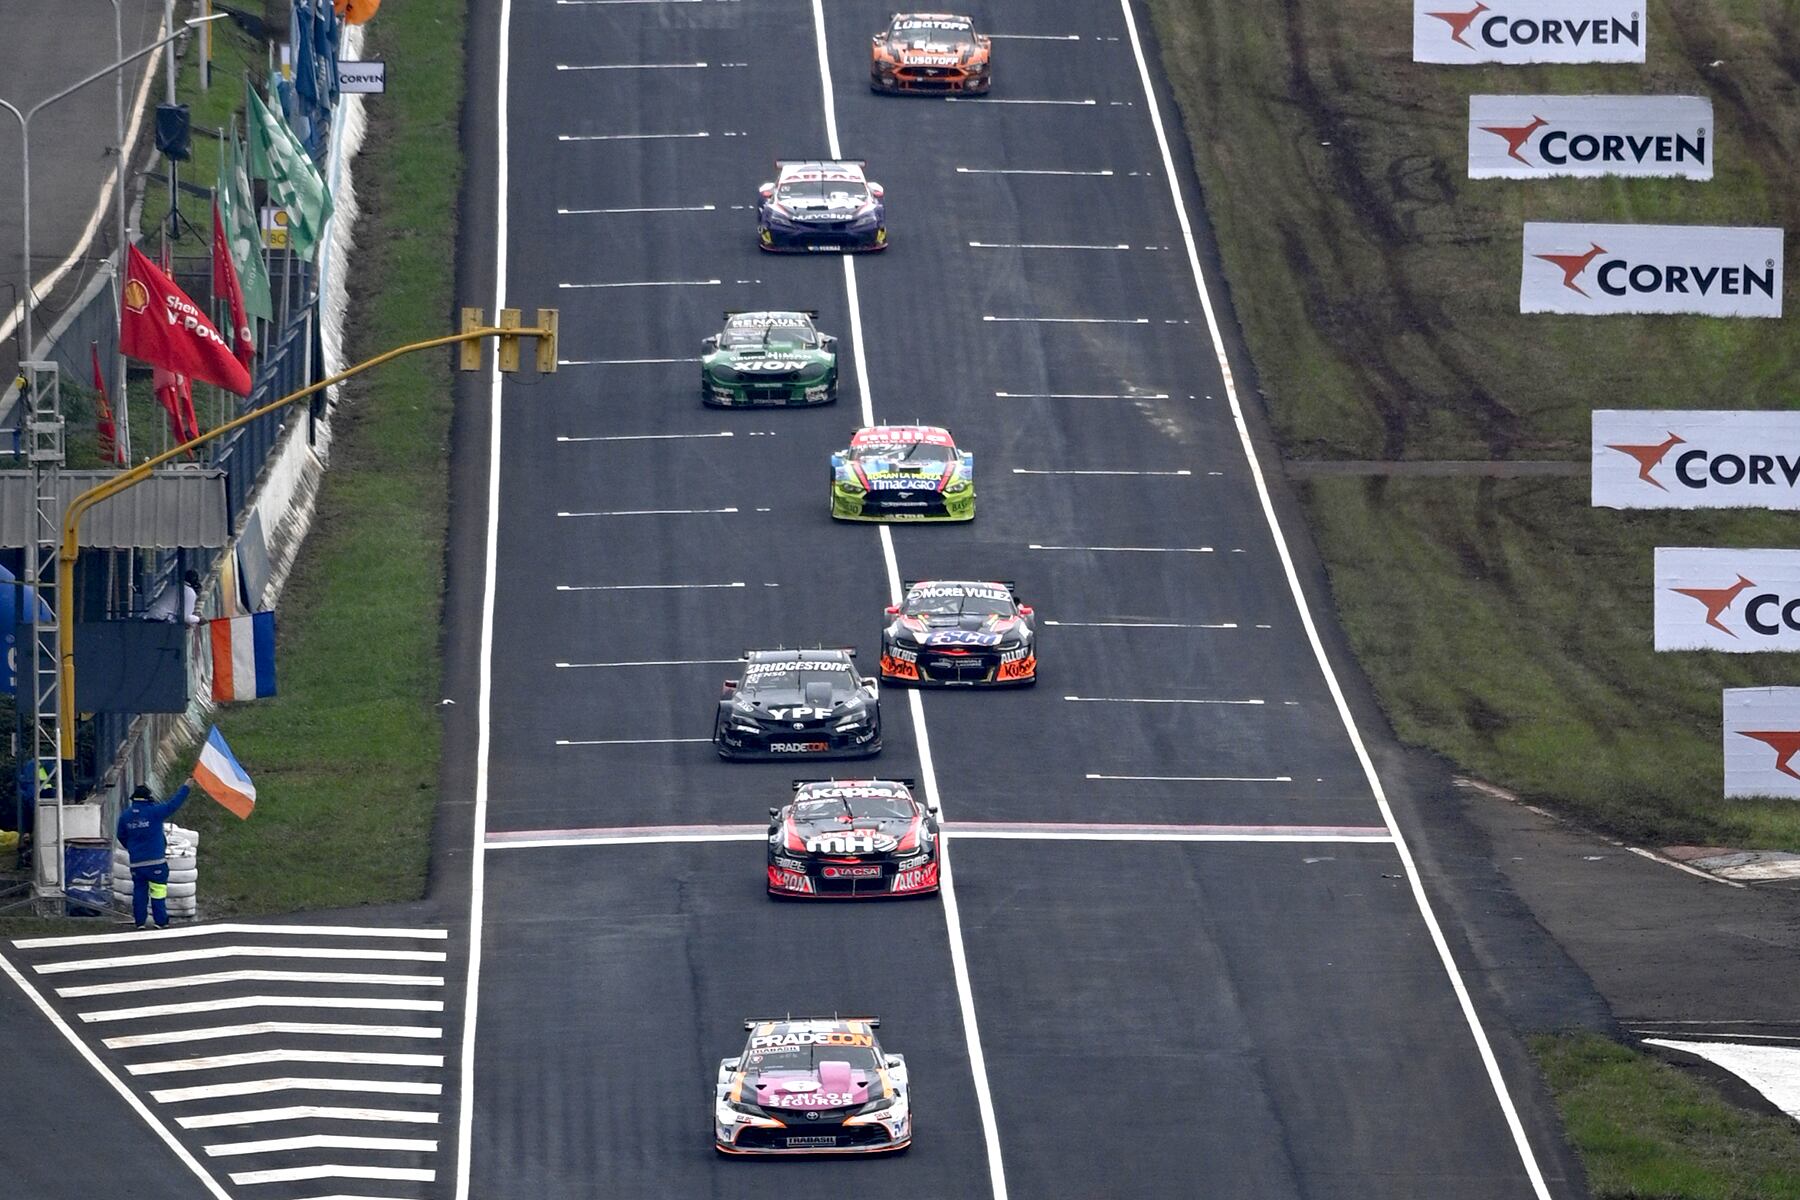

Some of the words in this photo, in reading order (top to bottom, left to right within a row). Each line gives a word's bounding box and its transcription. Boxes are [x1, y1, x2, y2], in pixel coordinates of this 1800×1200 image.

[1481, 15, 1639, 47] CORVEN
[340, 74, 383, 84] CORVEN
[1539, 130, 1705, 166] CORVEN
[1597, 259, 1774, 299] CORVEN
[732, 318, 807, 328] RENAULT
[922, 587, 965, 598] MOREL
[746, 661, 852, 674] BRIDGESTONE
[767, 707, 834, 720] YPF
[770, 742, 829, 753] PRADECON
[751, 1033, 873, 1048] PRADECON
[768, 1099, 853, 1107] SEGUROS
